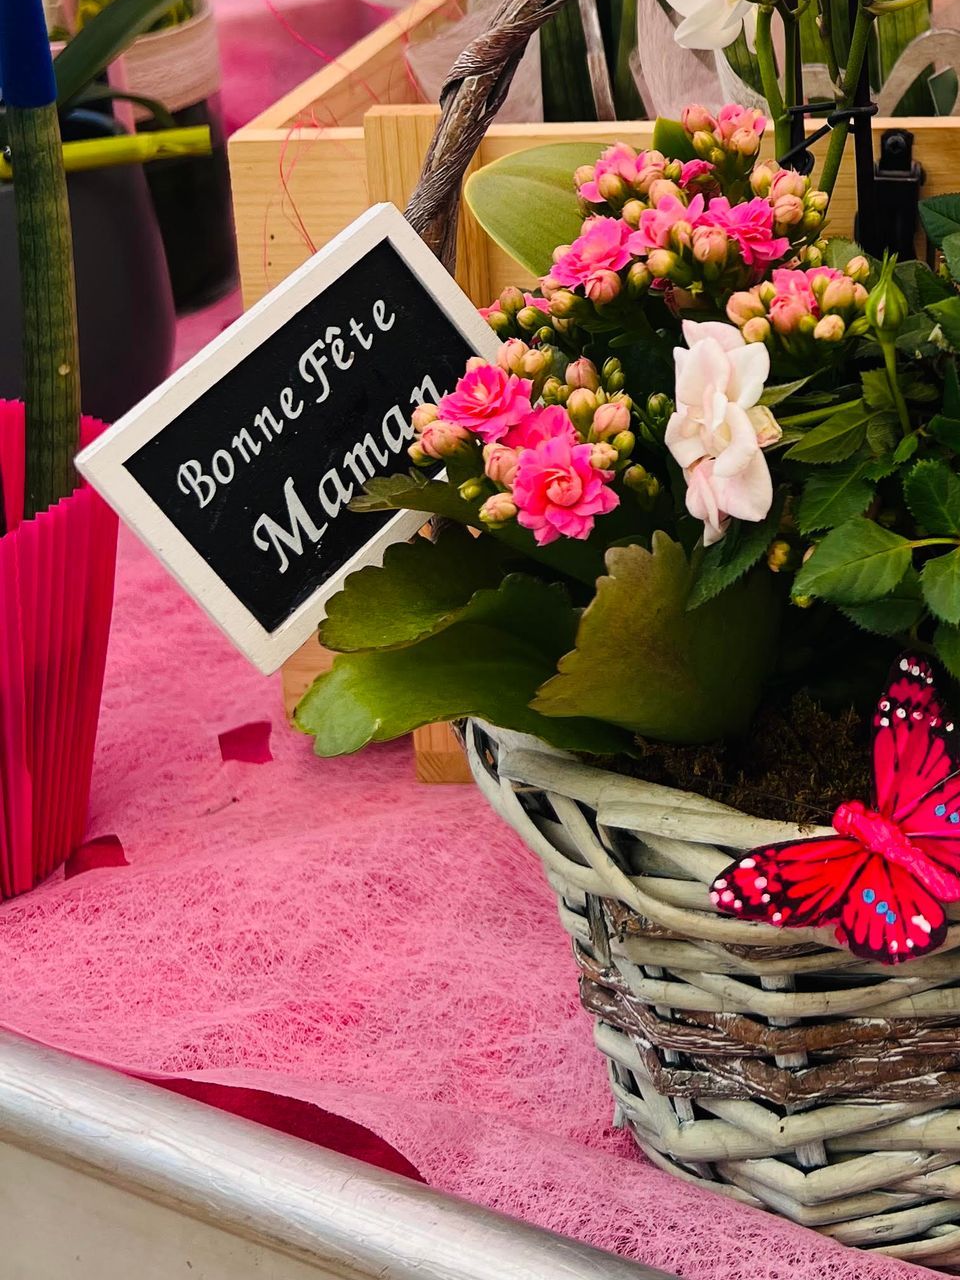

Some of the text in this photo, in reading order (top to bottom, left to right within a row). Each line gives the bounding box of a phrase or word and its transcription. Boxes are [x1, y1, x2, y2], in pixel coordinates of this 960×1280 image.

[177, 298, 396, 509] Bonne Fête
[253, 374, 449, 574] Maman
